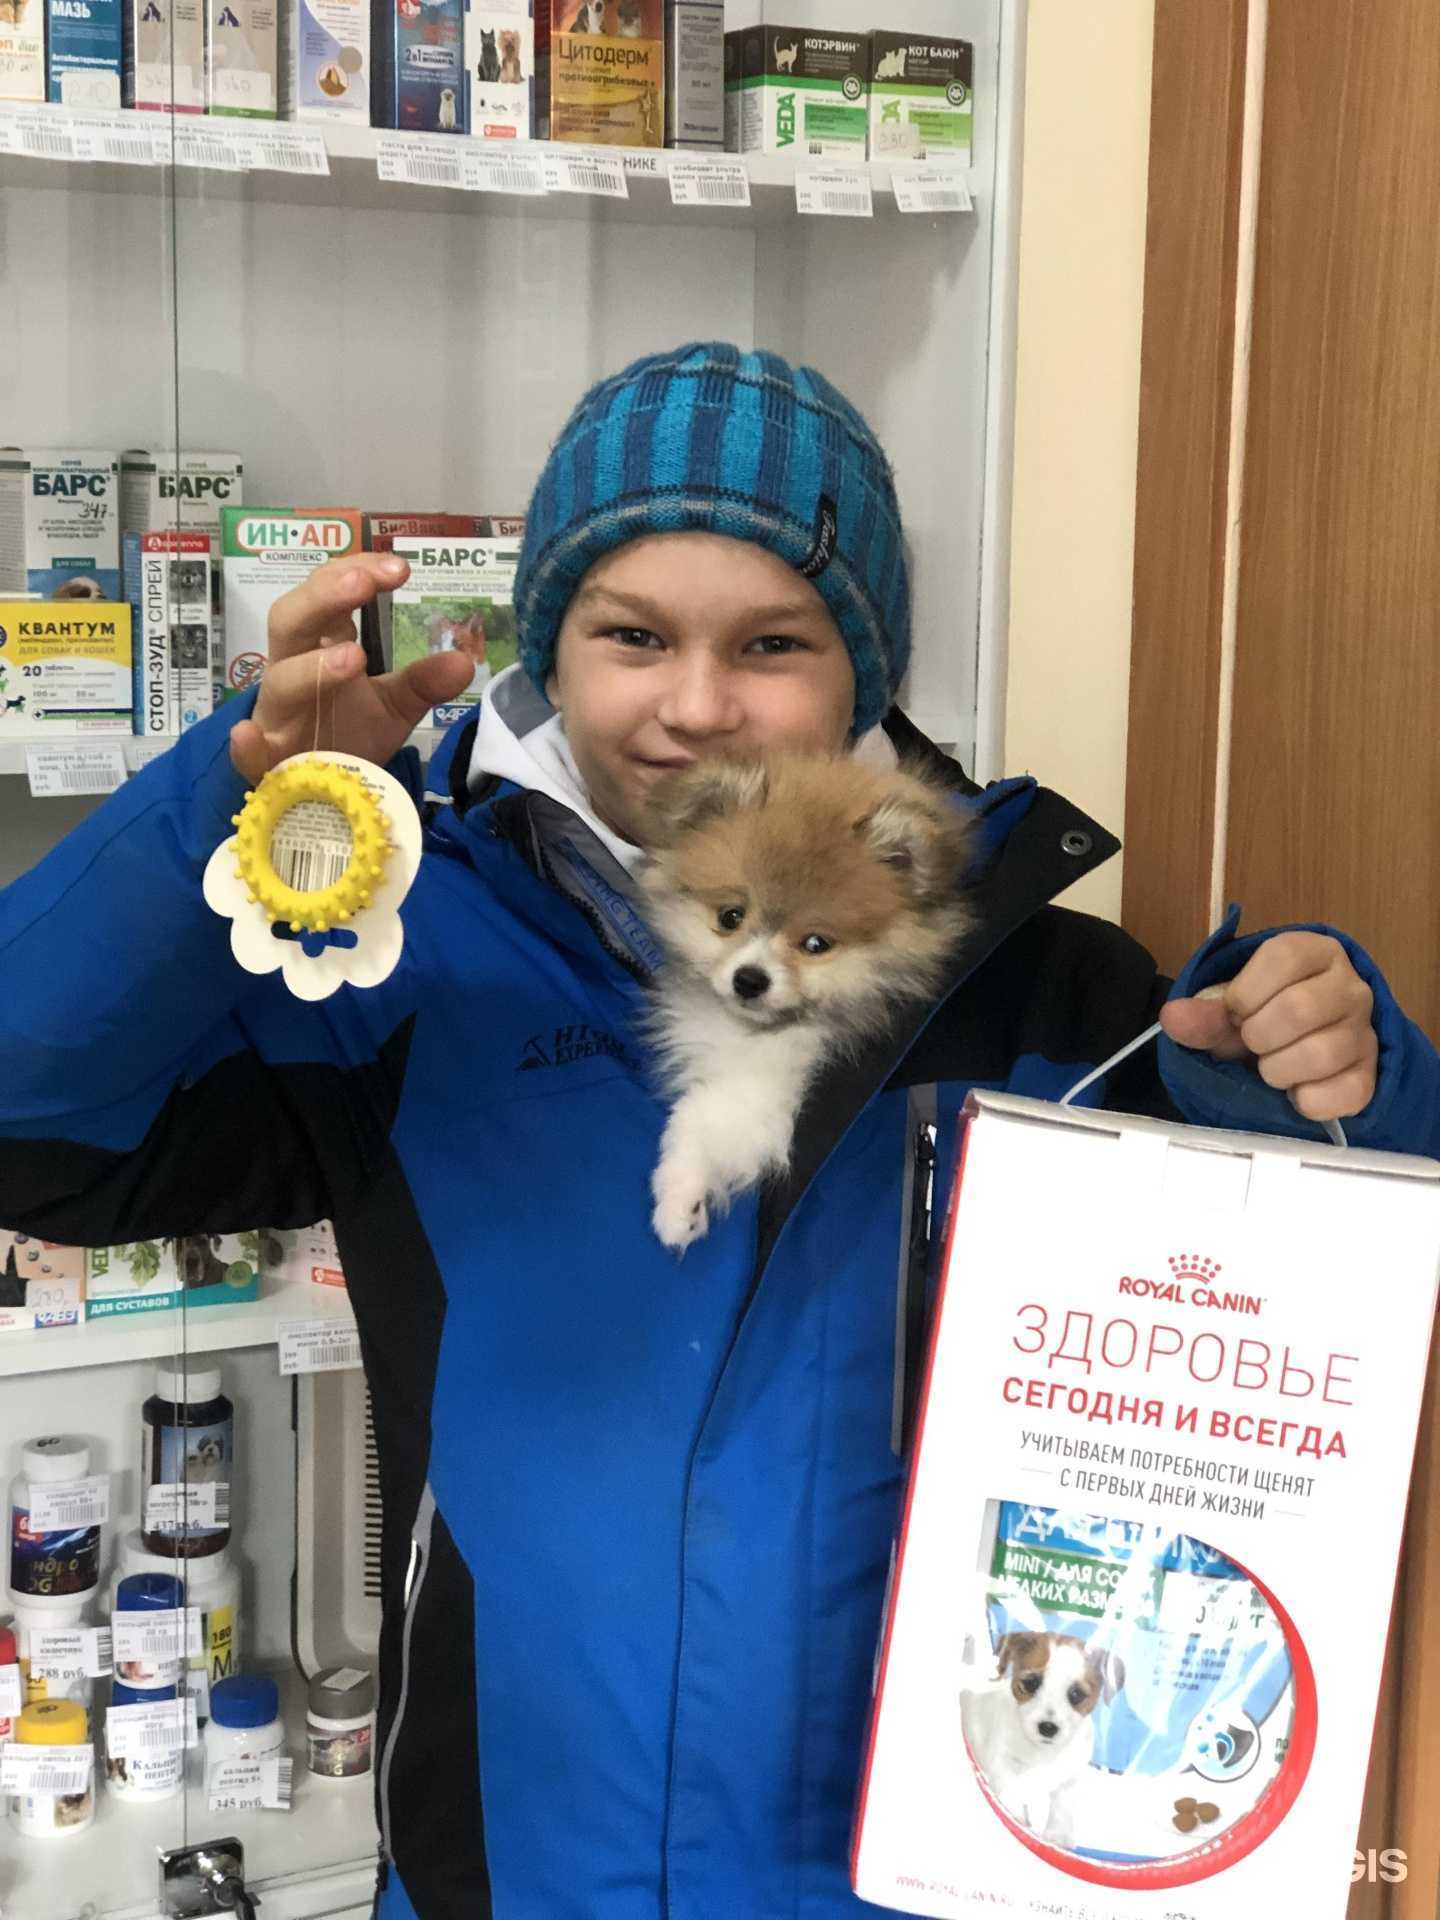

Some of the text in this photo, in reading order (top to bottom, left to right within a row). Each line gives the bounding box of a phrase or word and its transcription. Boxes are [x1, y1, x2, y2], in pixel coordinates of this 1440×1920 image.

[51, 1, 91, 18] МАЗЬ
[559, 37, 649, 69] Цитодерм
[804, 37, 856, 53] КОТЭРВИН
[908, 45, 960, 59] КОТ БАЮН
[776, 92, 795, 147] VEDA
[33, 474, 106, 497] БАРС
[159, 476, 231, 499] БАРС
[265, 551, 323, 562] КОМПЛЕКС
[422, 549, 488, 567] БАРС
[148, 560, 163, 622] СПРЕЙ
[18, 622, 115, 636] КВАНТУМ
[22, 665, 42, 677] 20
[149, 635, 165, 731] СТОП-ЗУД
[90, 1296, 170, 1316] ДЛЯ СУСТАВОВ
[1118, 1276, 1263, 1316] ROYAL CANIN
[1013, 1304, 1360, 1406] ЗДОРОВЬЕ
[1002, 1376, 1347, 1459] СЕГОДНЯ И ВСЕГДА
[1020, 1430, 1316, 1498] УЧИТЫВАЕМ ПОТРЕБНОСТИ ЩЕНЯТ
[1059, 1467, 1265, 1520] С ПЕРВЫХ ДНЕЙ ЖИЗНИ
